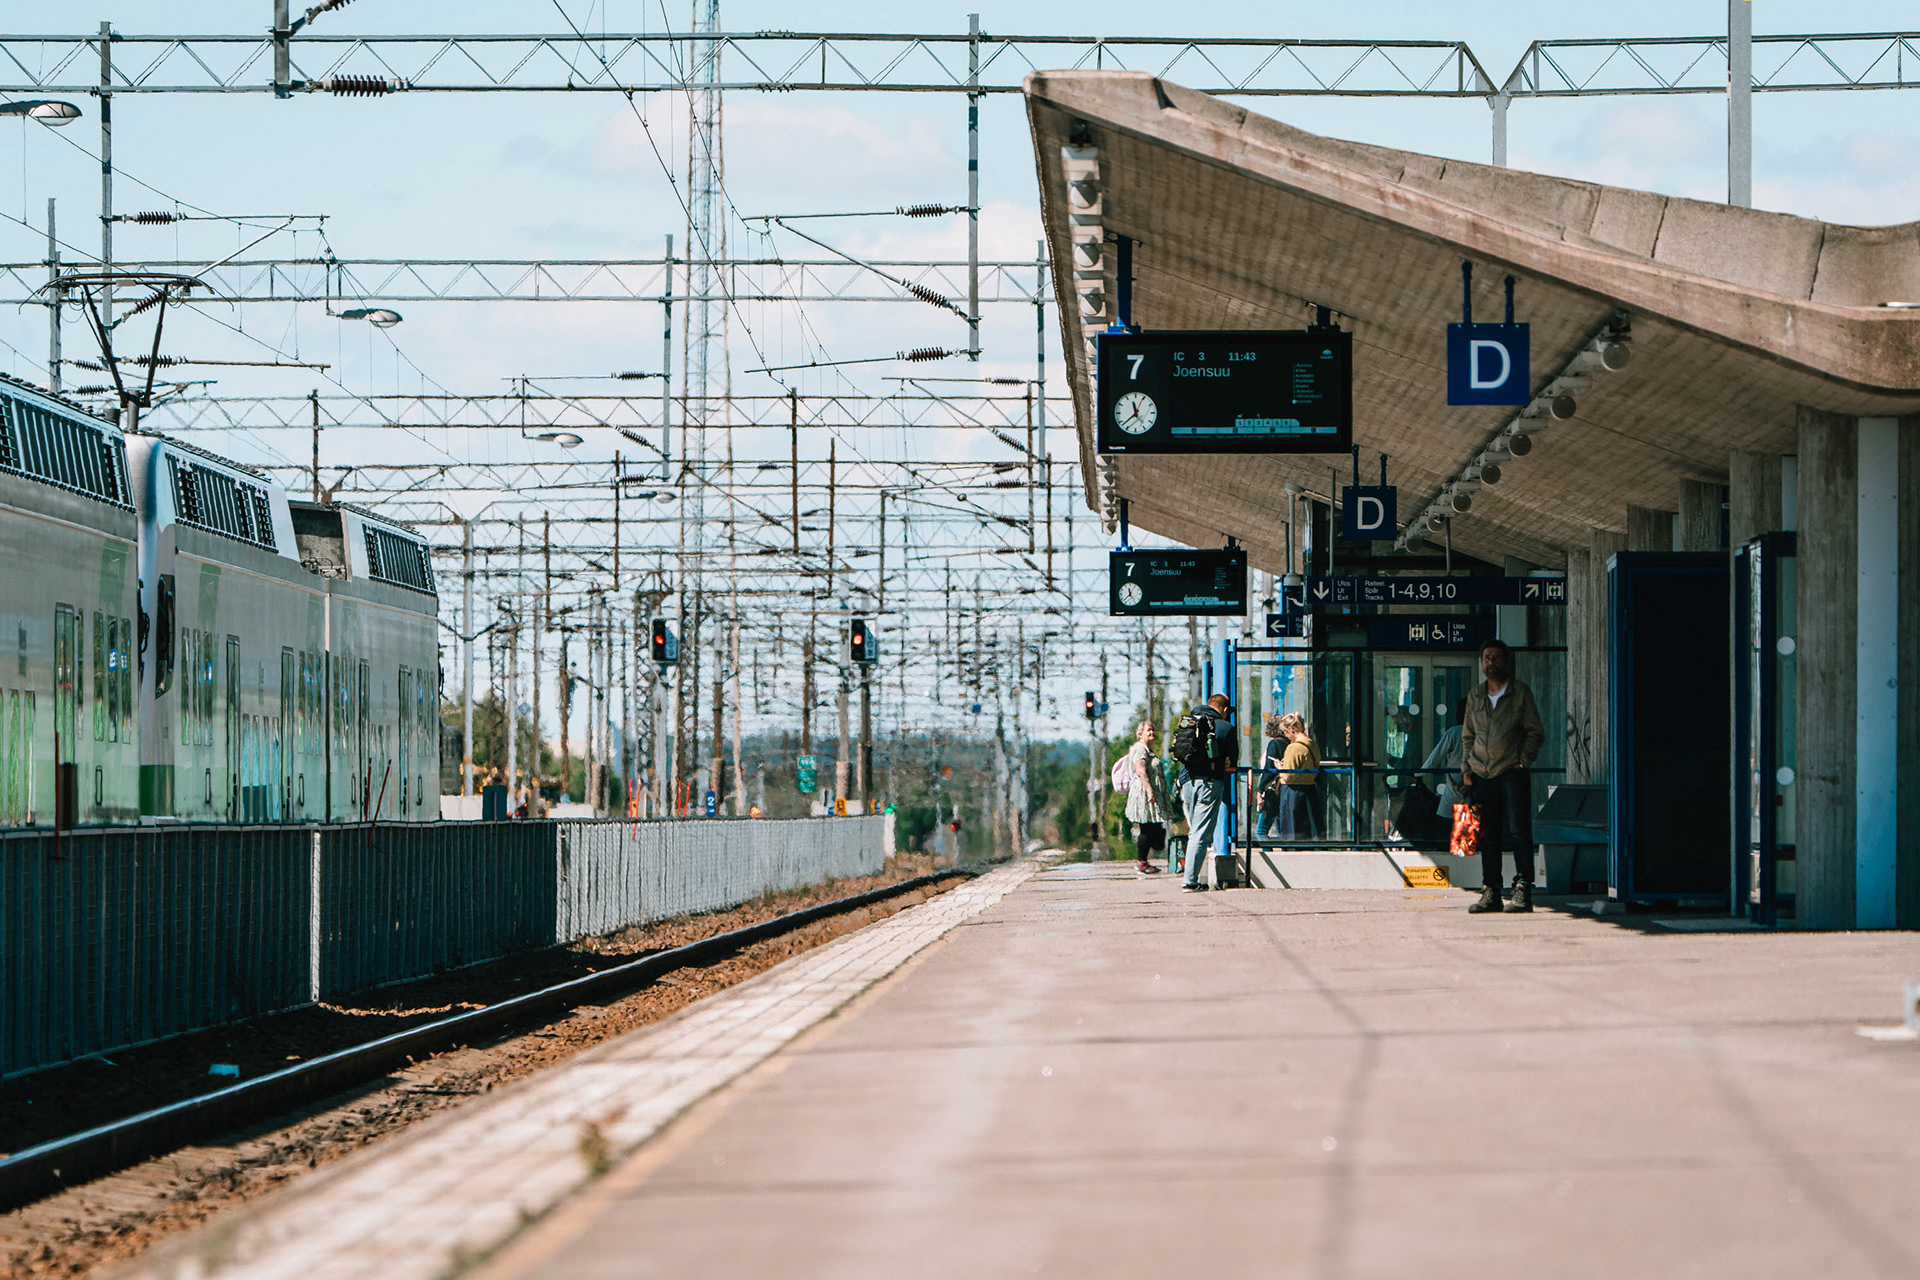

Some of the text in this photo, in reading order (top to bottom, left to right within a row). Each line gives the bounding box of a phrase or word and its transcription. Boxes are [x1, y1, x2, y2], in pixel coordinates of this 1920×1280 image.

[1173, 352, 1256, 361] IC 3 11:43
[1470, 340, 1511, 389] D
[1126, 354, 1145, 380] 7
[1173, 365, 1231, 377] Joensuu
[1357, 496, 1385, 529] D
[1125, 562, 1135, 577] 7
[1150, 568, 1182, 576] Joensuu
[1388, 583, 1456, 602] 1-4,9,10
